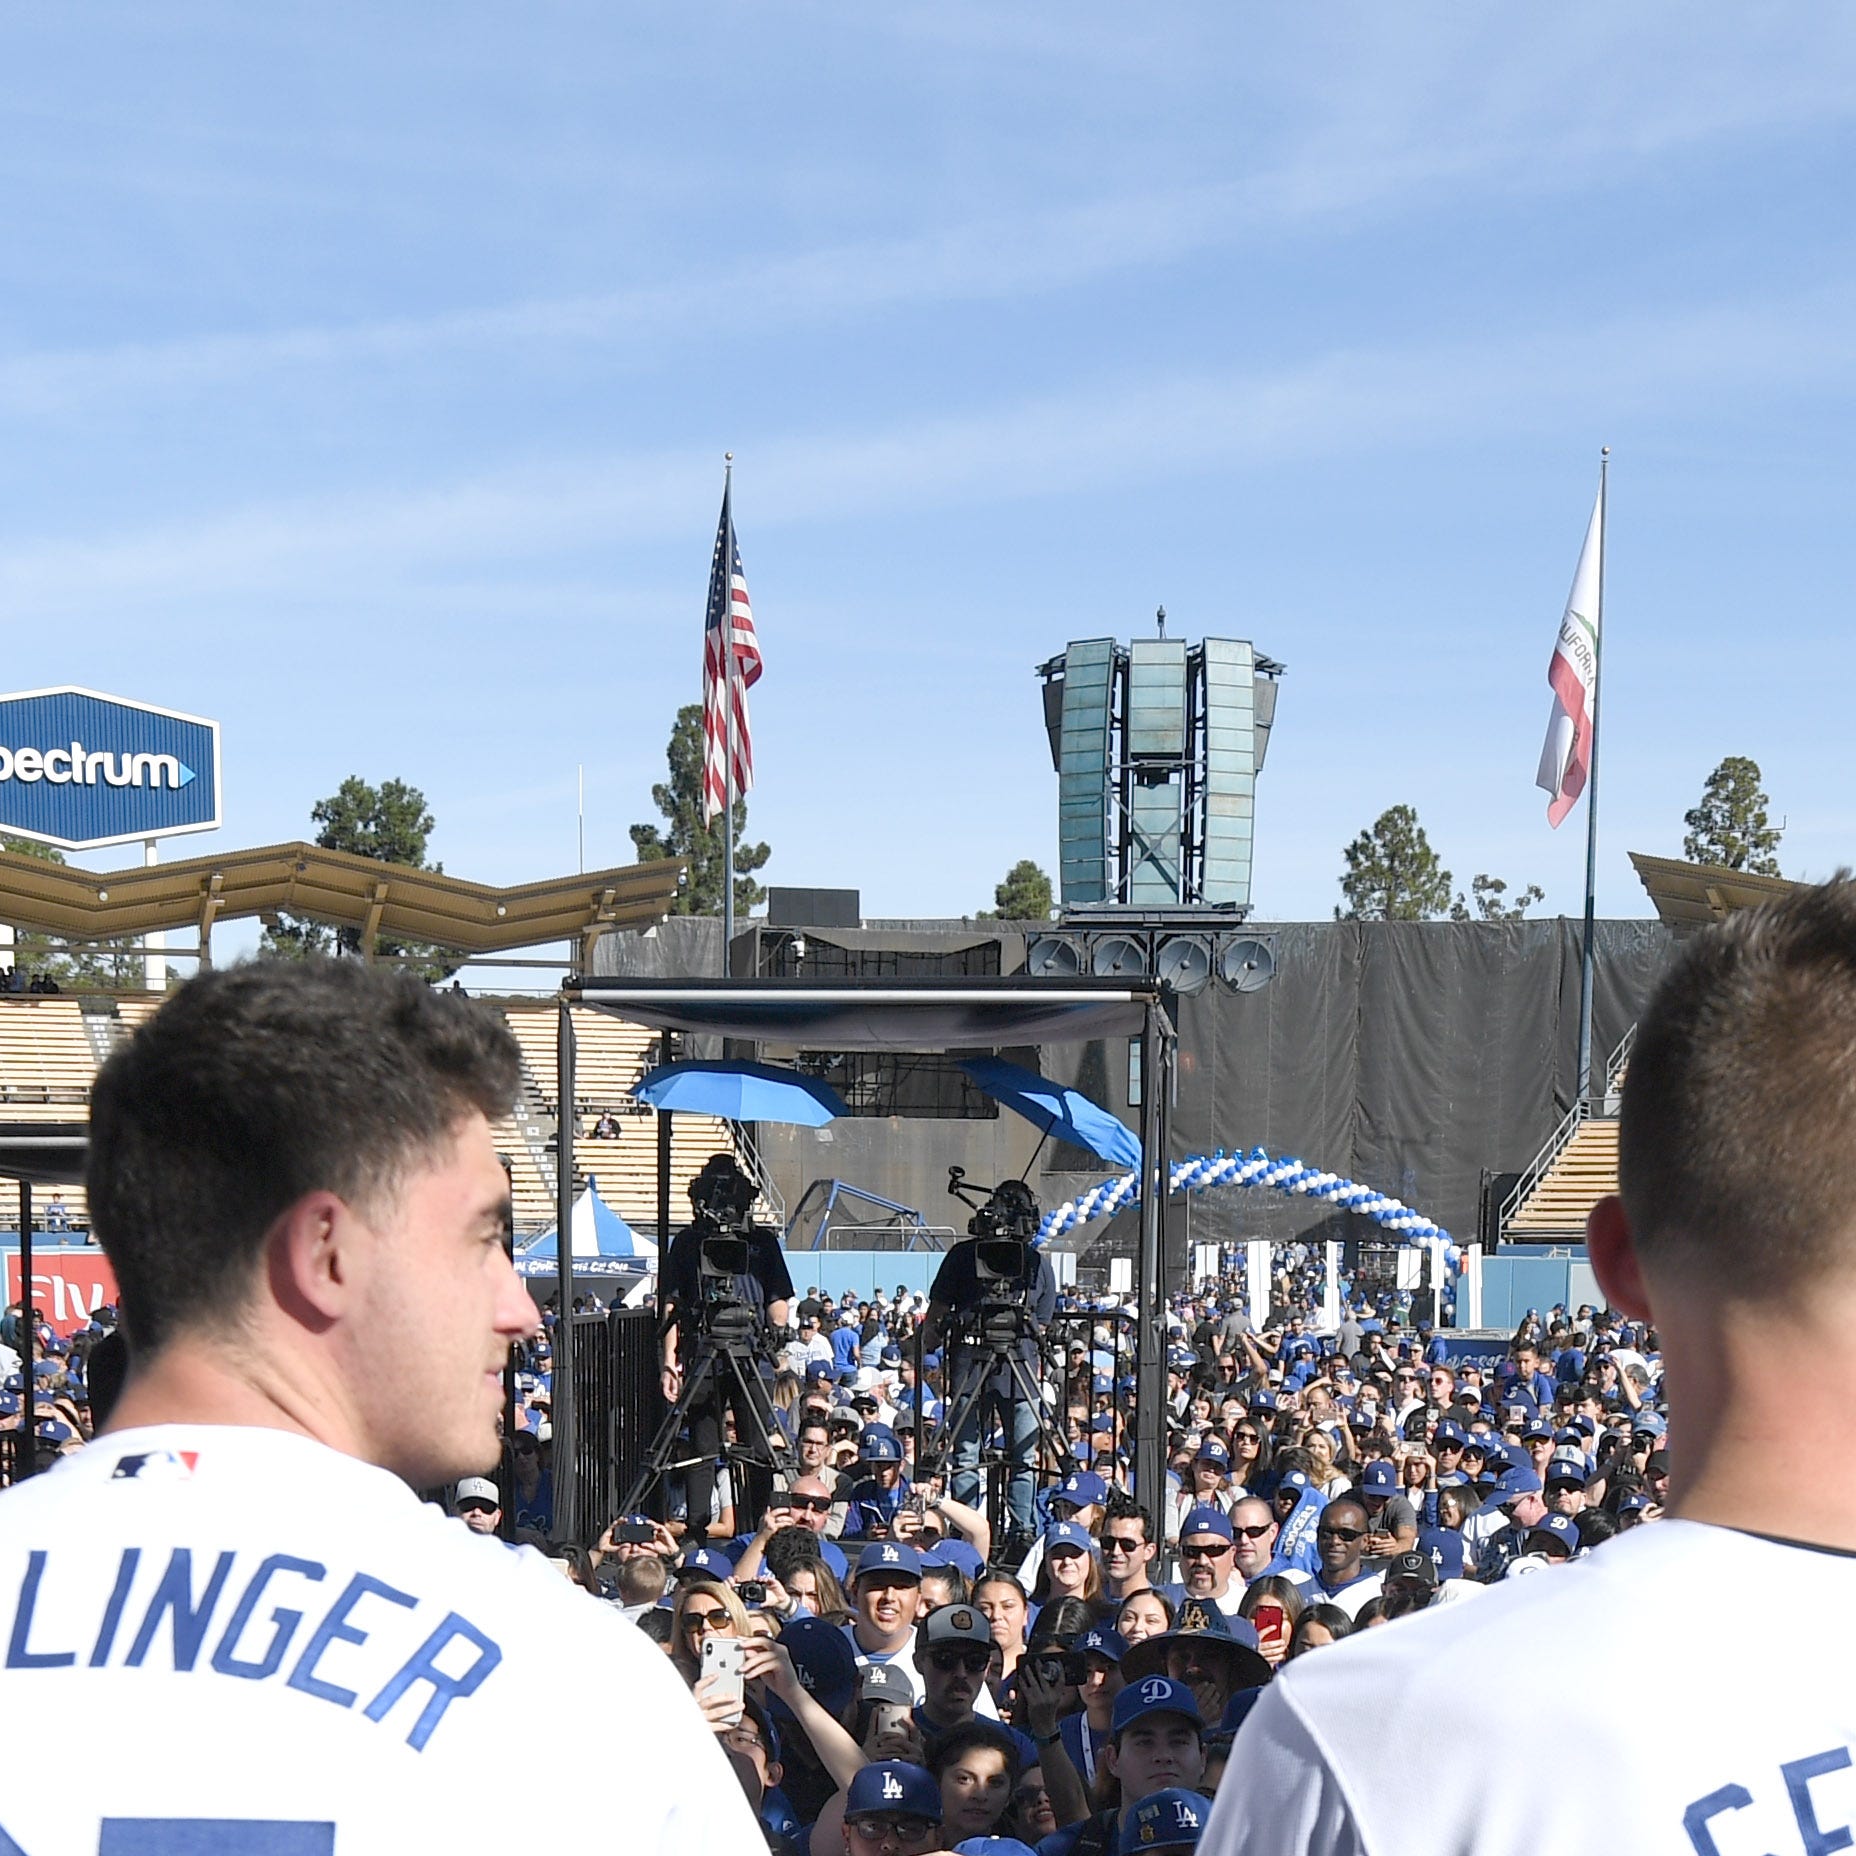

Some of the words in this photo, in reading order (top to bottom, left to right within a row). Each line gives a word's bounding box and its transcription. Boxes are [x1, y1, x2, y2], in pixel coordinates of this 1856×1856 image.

[1531, 1418, 1544, 1431] D
[1058, 1523, 1071, 1536] LA
[1551, 1516, 1569, 1530] D
[695, 1549, 709, 1566] LA
[882, 1545, 900, 1562] LA
[1430, 1546, 1443, 1565] LA
[1182, 1601, 1210, 1632] LA
[1086, 1631, 1103, 1646] LA
[796, 1664, 816, 1690] LA
[870, 1666, 887, 1683] LA
[1140, 1676, 1173, 1703] D
[882, 1771, 904, 1799] LA
[1175, 1800, 1199, 1828] LA
